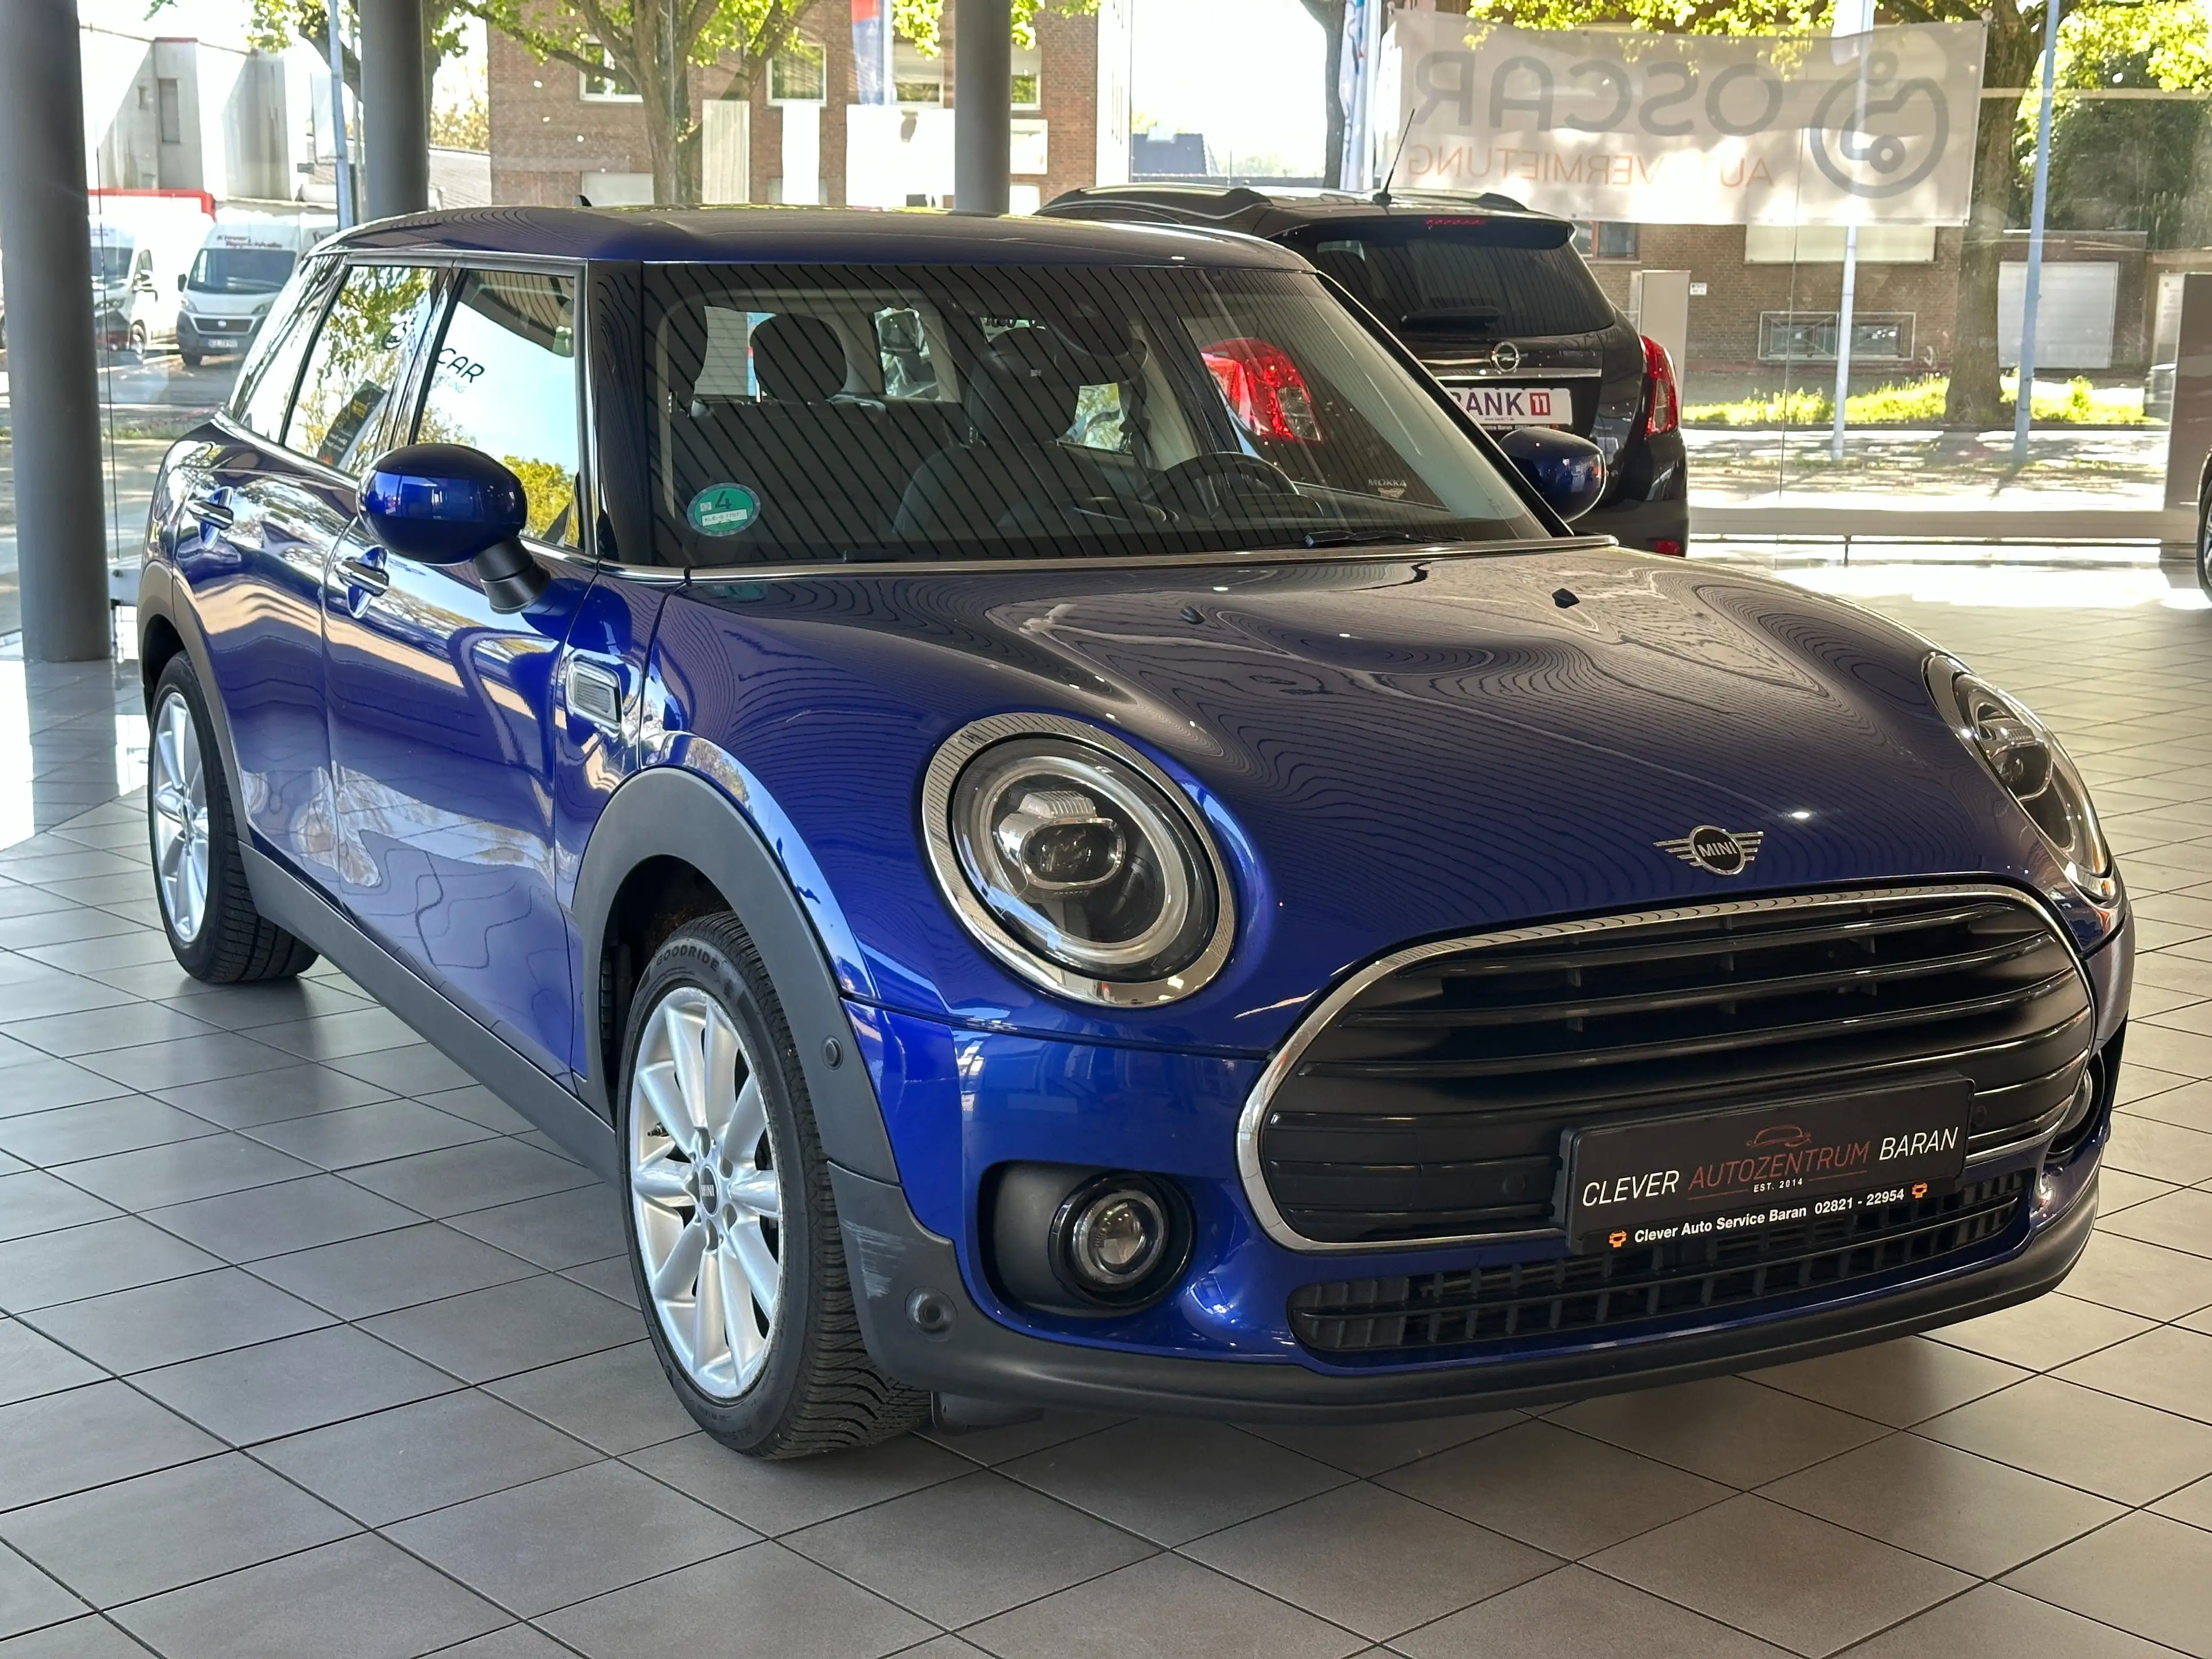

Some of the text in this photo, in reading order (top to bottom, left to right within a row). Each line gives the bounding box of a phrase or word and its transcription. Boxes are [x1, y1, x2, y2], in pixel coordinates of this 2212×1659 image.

[1532, 395, 1549, 414] 11
[1368, 478, 1407, 487] MOKKA
[715, 490, 733, 509] 4
[1697, 841, 1738, 857] MINI
[656, 945, 720, 972] GOODRIDE
[1582, 1126, 1959, 1207] CLEVER AUTOZENTRUM BARAN
[700, 1184, 715, 1197] MINI
[1753, 1178, 1804, 1193] EST. 2014
[1634, 1228, 1679, 1243] Clever
[1681, 1221, 1713, 1236] Auto
[1716, 1214, 1766, 1231] Service
[1768, 1207, 1808, 1222] Baran
[1814, 1197, 1853, 1215] 02821
[1865, 1188, 1904, 1207] 22954
